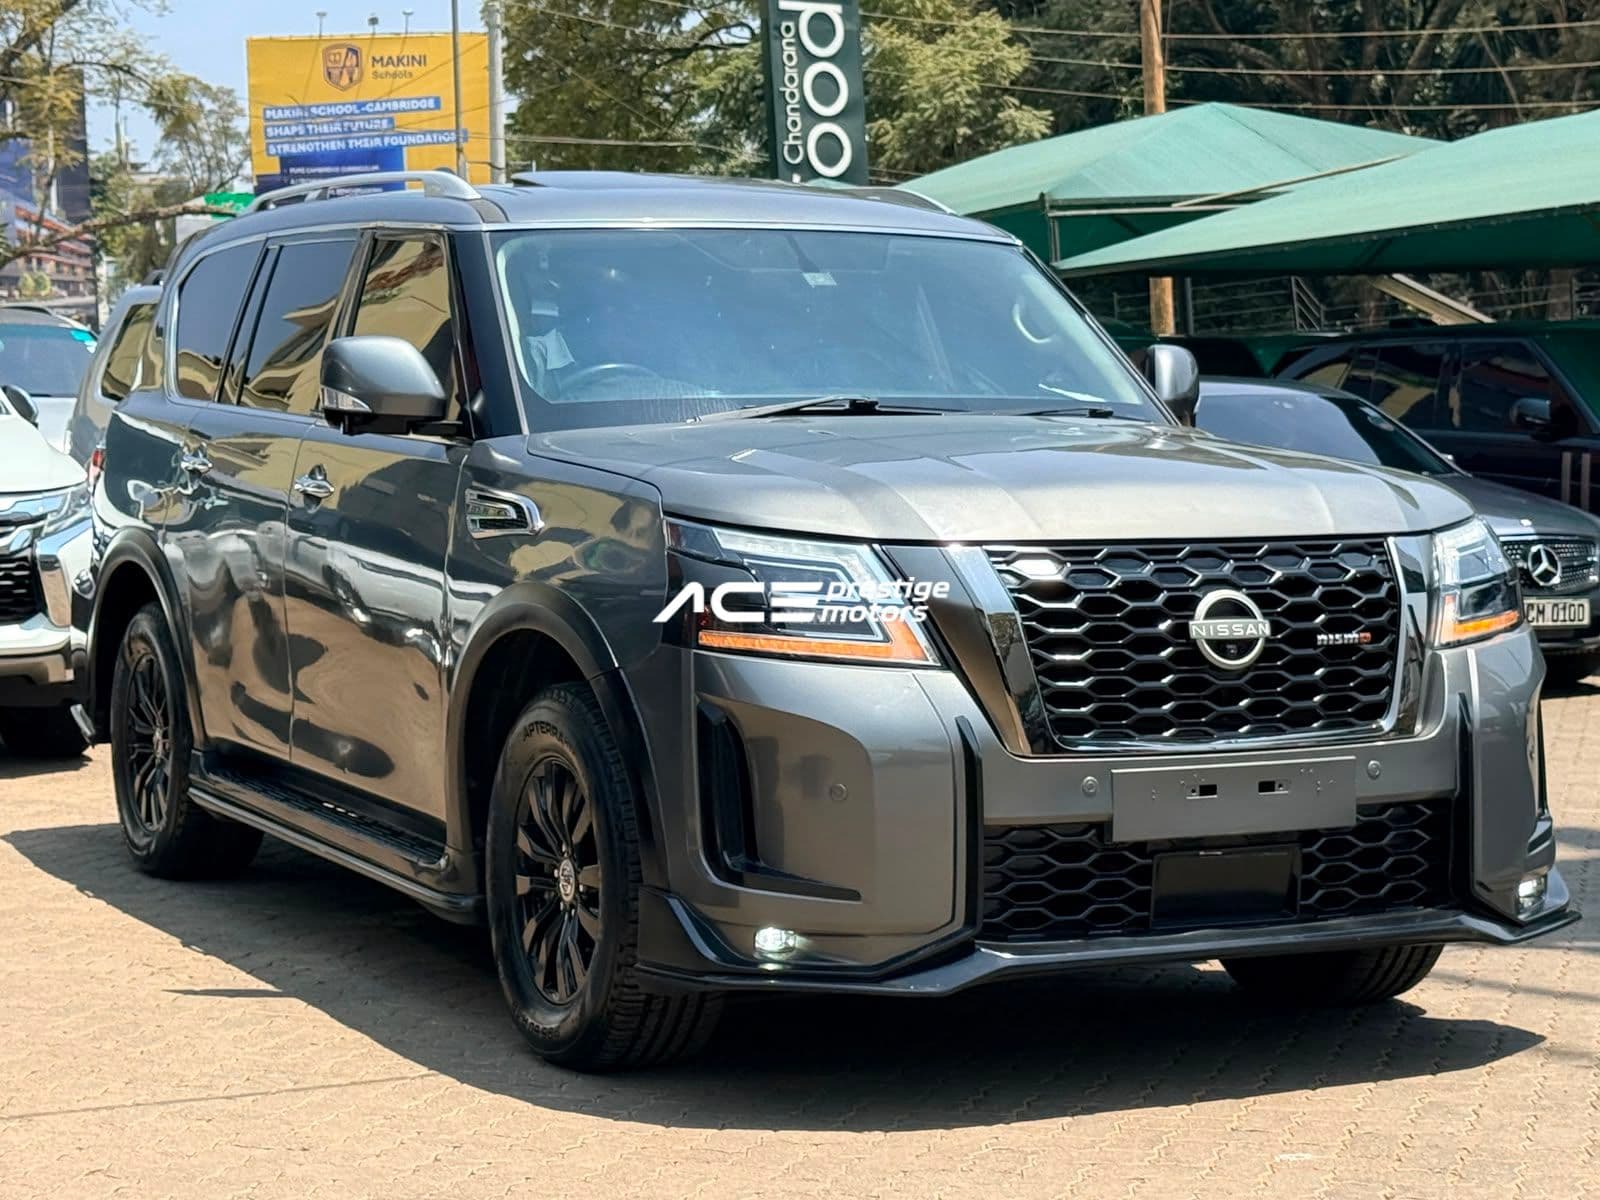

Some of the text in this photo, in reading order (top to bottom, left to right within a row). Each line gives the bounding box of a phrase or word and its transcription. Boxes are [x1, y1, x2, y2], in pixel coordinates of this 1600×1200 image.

[371, 54, 427, 68] MAKINI
[371, 70, 414, 80] Schools
[778, 0, 853, 183] ood
[780, 21, 805, 165] Chandarana
[1191, 623, 1271, 637] NISSAN
